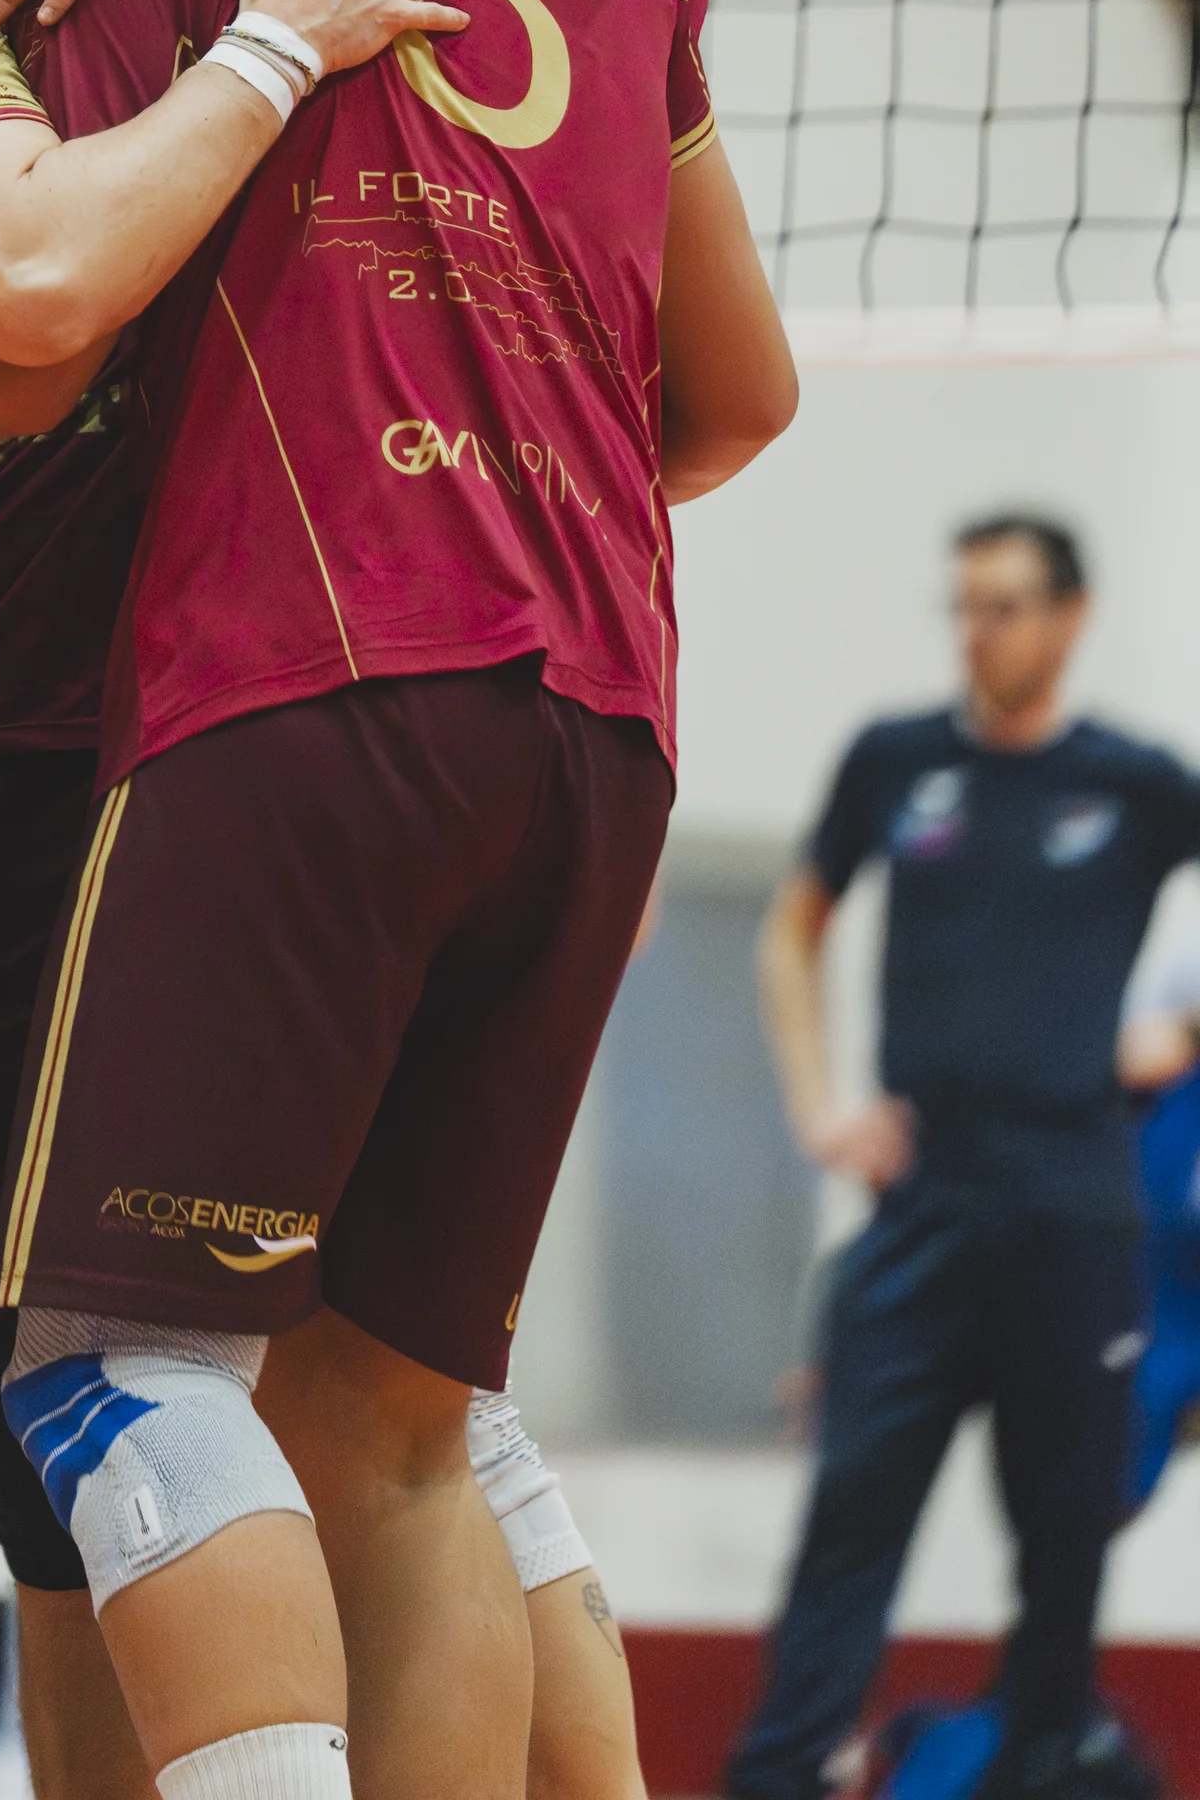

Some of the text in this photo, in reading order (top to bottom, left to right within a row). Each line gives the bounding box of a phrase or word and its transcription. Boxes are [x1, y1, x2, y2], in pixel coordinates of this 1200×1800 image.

[293, 171, 511, 234] IL FORTE
[388, 269, 471, 303] 2.0
[100, 1186, 320, 1240] ACOSENERGIA
